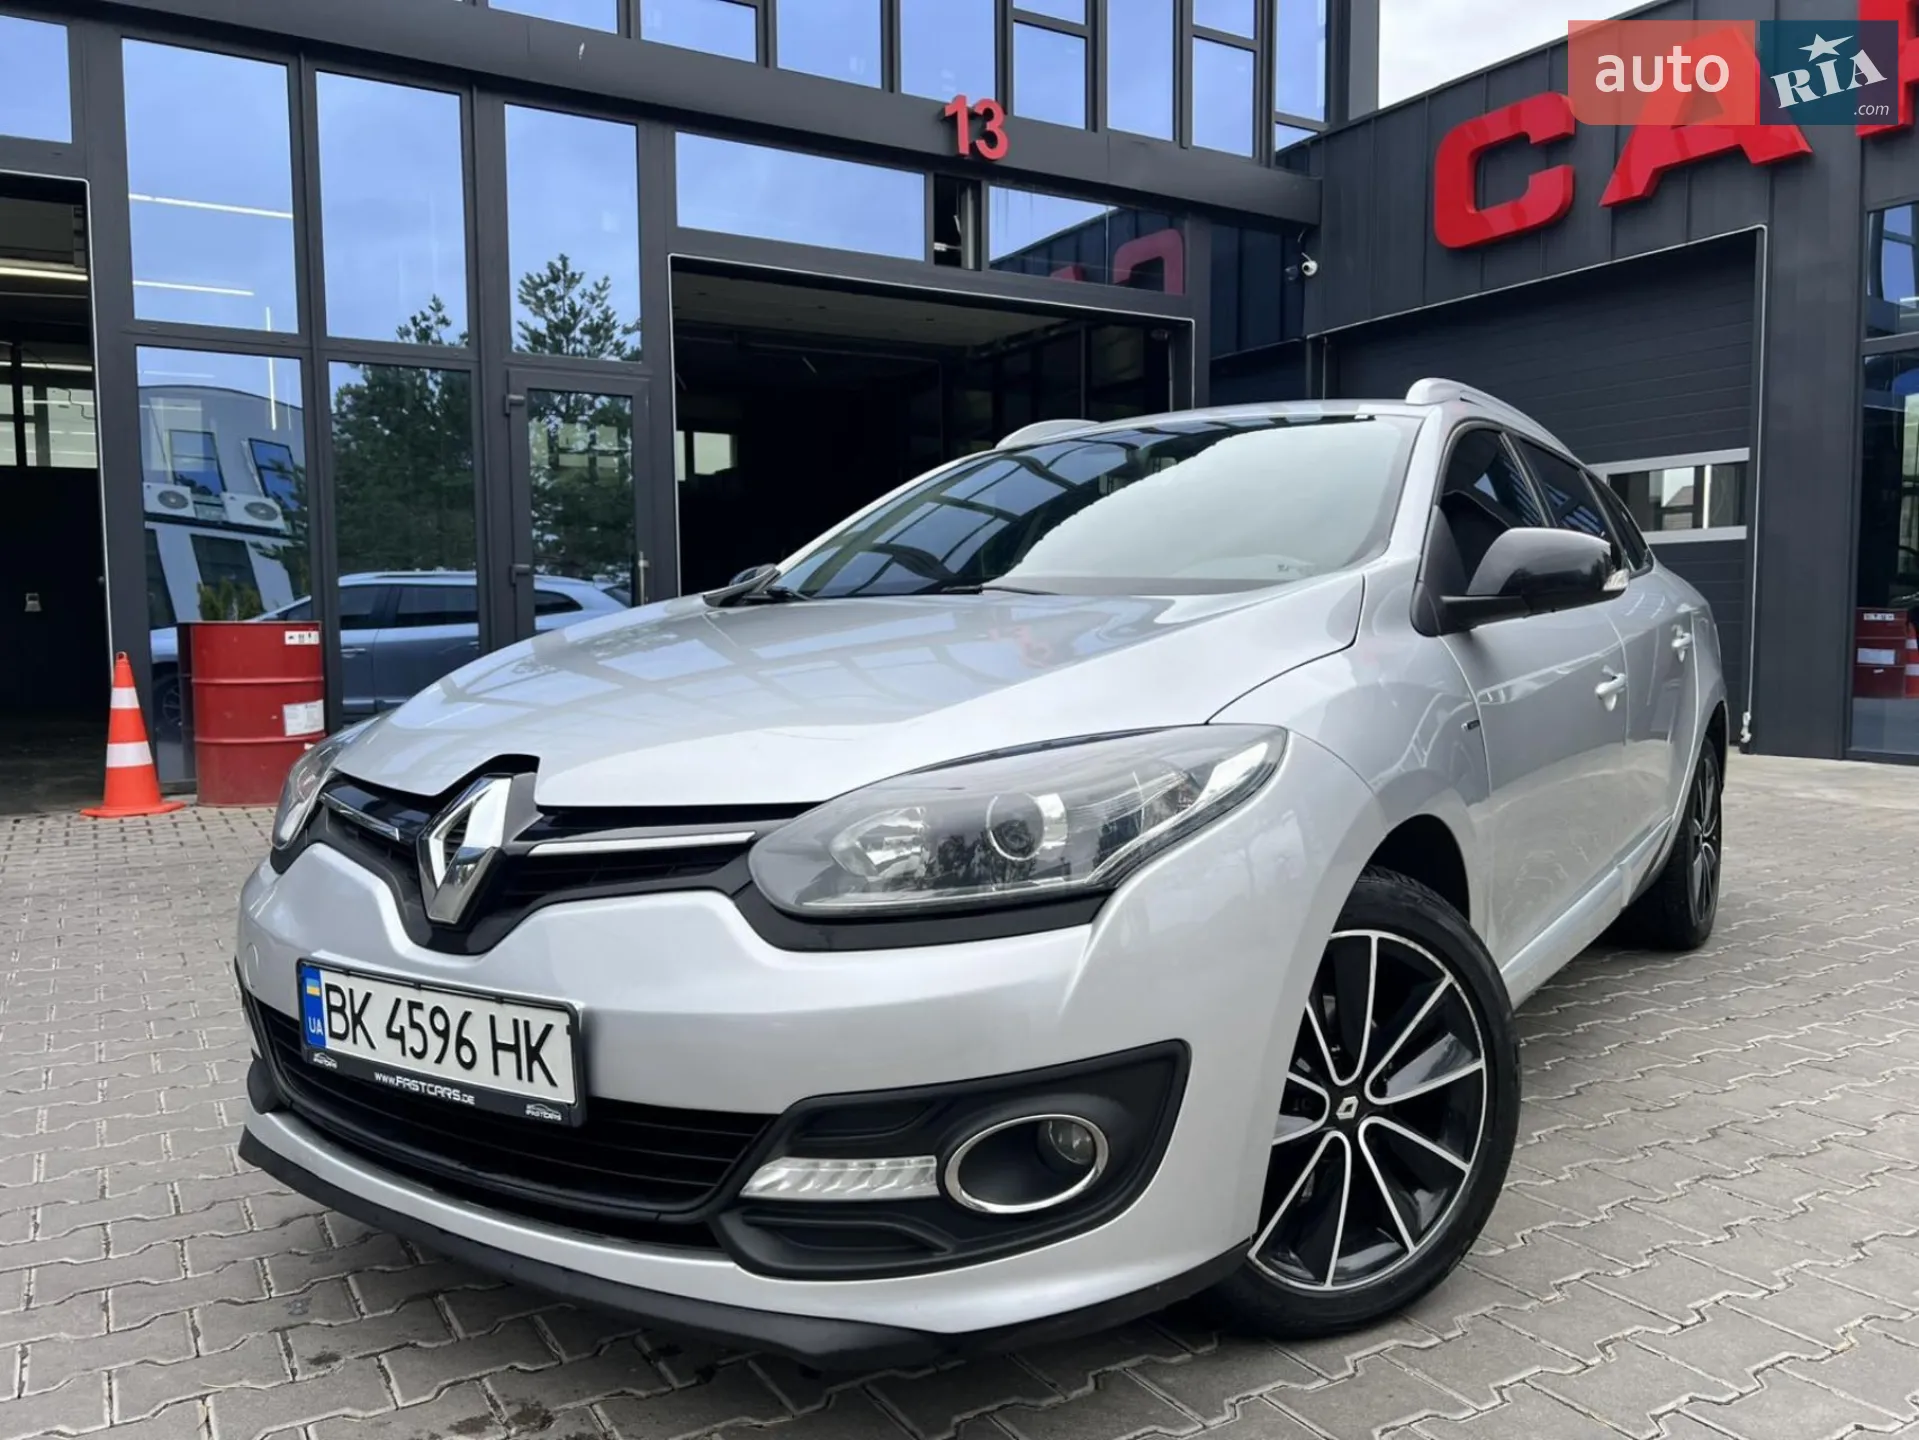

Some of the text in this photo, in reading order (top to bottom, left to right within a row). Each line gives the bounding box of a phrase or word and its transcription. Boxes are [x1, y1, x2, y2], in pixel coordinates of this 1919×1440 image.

[944, 94, 1010, 161] 13
[308, 1019, 324, 1037] UA
[324, 983, 558, 1088] BK 4596 HK
